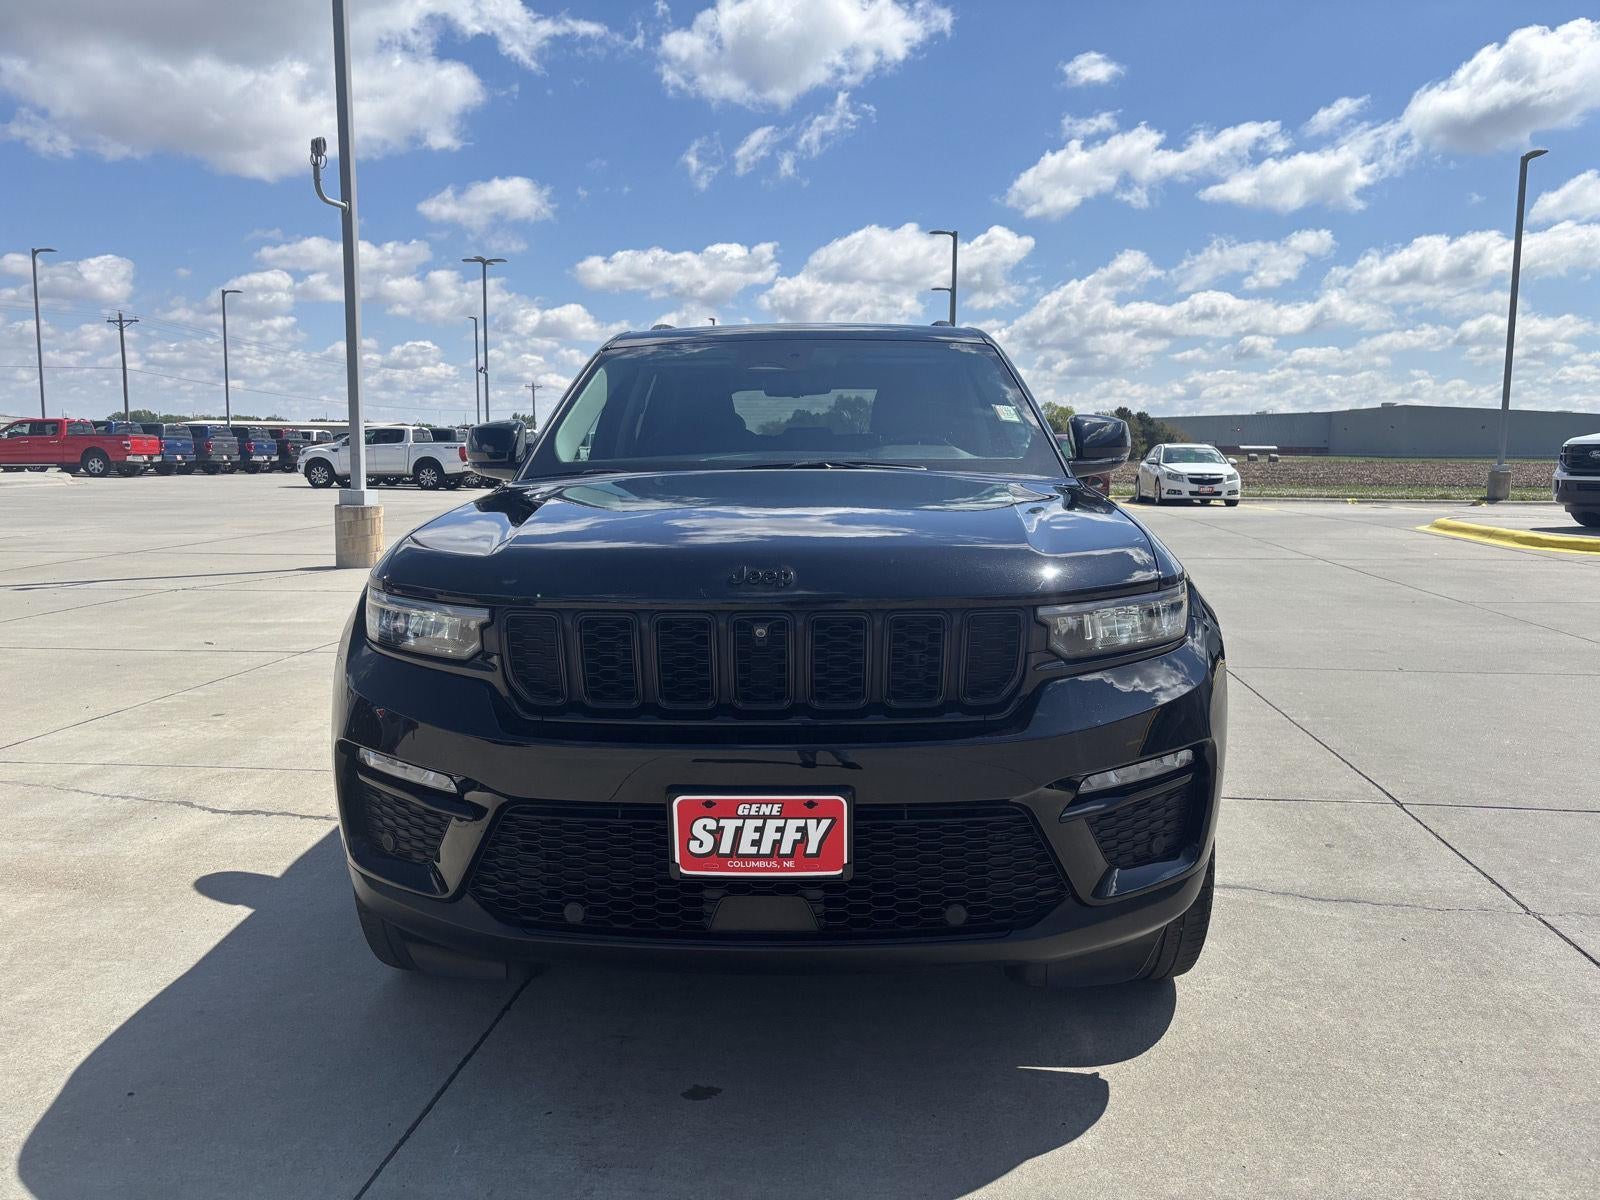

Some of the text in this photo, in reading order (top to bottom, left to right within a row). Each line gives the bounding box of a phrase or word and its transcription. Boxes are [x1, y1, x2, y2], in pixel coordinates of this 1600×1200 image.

[730, 566, 794, 588] Jeep
[736, 803, 783, 816] GENE
[688, 817, 834, 856] STEFFY
[727, 860, 796, 869] COLUMBUS, NE
